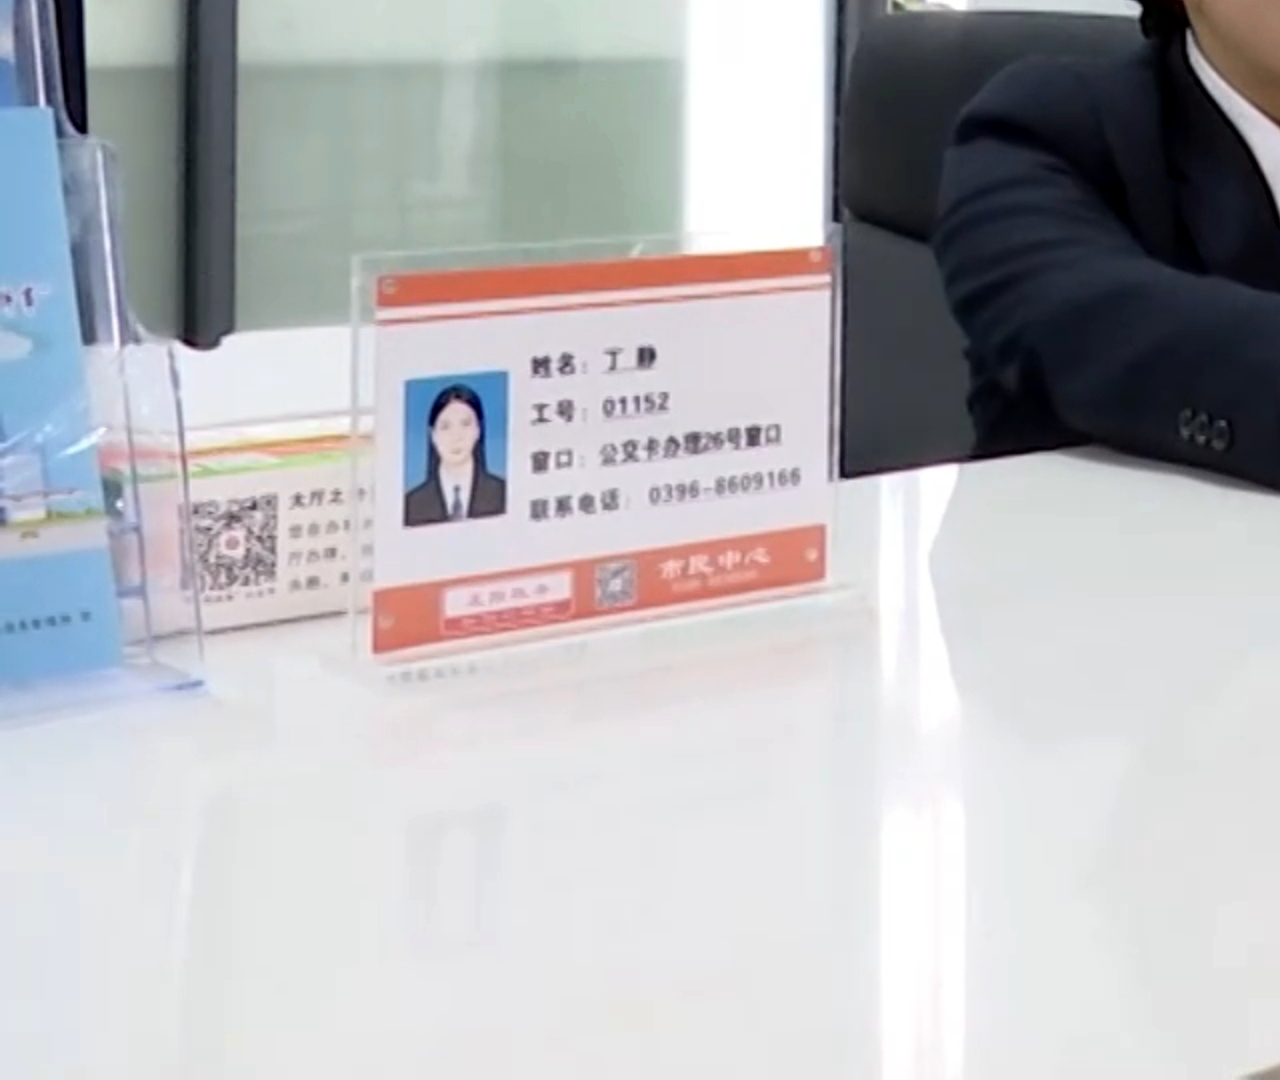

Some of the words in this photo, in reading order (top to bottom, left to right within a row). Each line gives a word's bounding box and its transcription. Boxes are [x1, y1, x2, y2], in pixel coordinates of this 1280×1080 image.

[603, 347, 623, 372] 丁
[602, 391, 670, 418] 01152
[599, 423, 782, 466] 公交卡办理26号窗口
[659, 547, 771, 581] 市民中心
